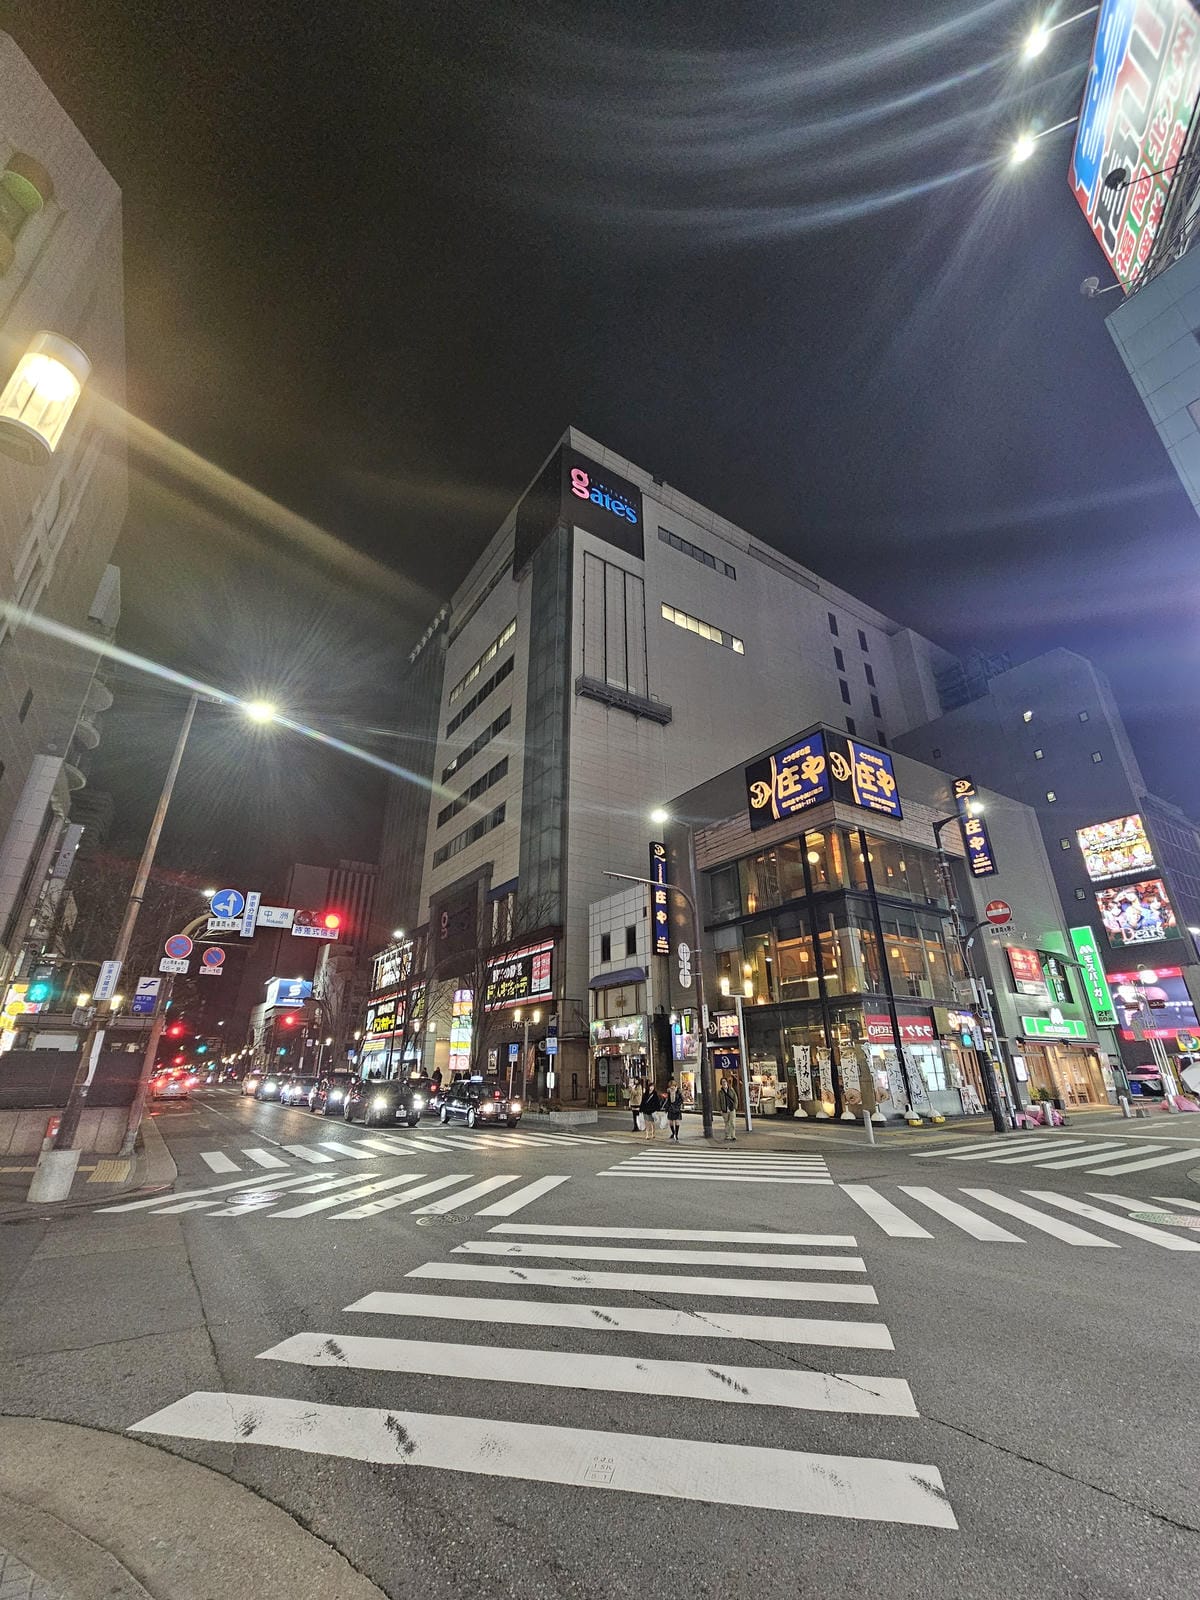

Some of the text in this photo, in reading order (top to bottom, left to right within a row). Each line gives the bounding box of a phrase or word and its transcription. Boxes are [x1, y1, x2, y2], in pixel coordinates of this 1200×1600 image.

[1116, 163, 1153, 277] 福岡
[571, 468, 638, 524] gates
[776, 755, 826, 800] 庄や
[855, 761, 896, 797] 庄や
[965, 819, 985, 851] 庄や
[263, 910, 289, 920] 中洲
[655, 890, 668, 925] 庄や
[294, 926, 337, 938] 時差式信号
[1083, 955, 1103, 1006] モスバーガー
